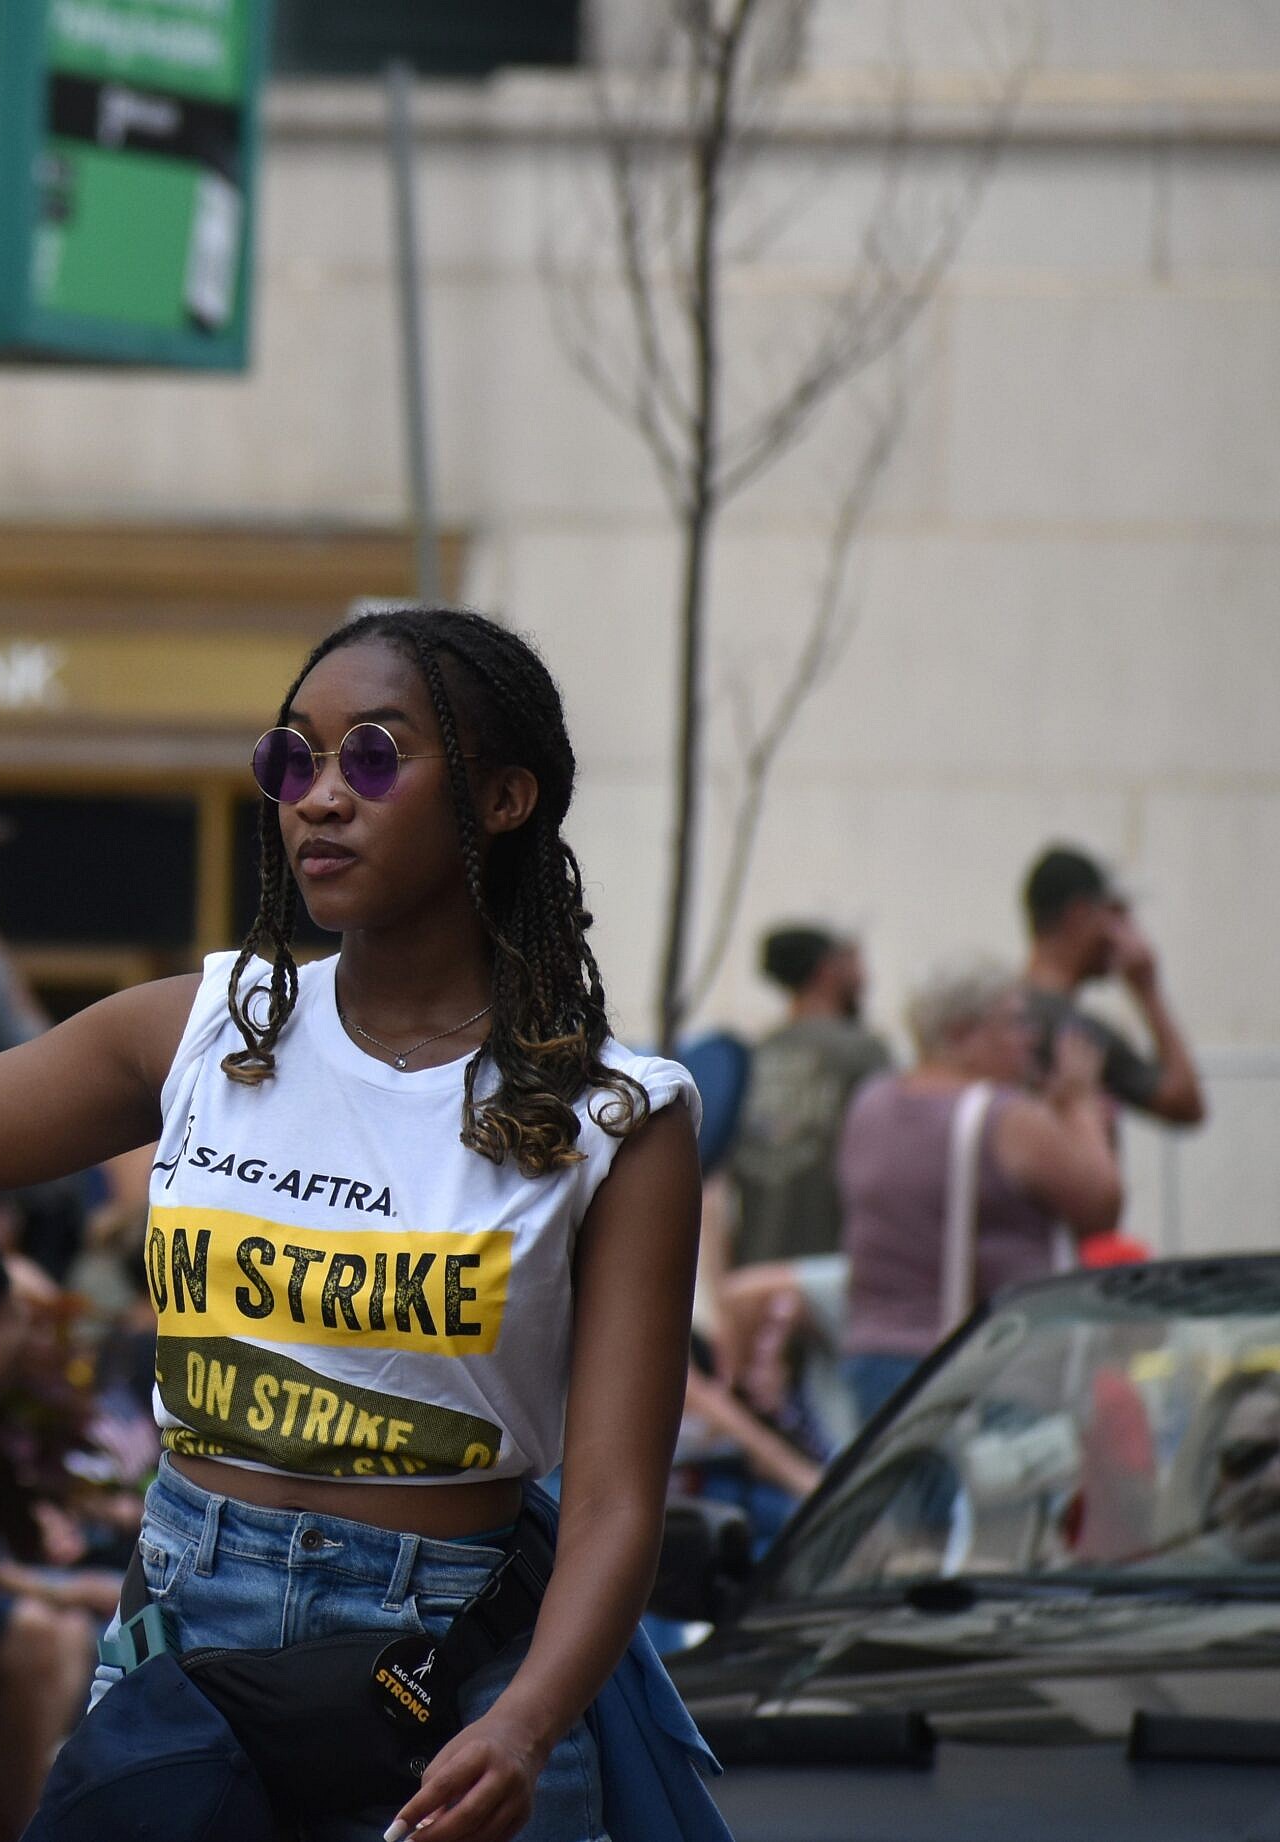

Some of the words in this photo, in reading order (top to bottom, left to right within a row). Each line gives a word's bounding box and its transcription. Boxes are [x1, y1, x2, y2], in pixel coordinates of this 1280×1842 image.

[148, 1226, 212, 1315] ON
[235, 1236, 482, 1337] STRIKE
[186, 1351, 237, 1421] ON
[246, 1374, 414, 1453] STRIKE
[376, 1669, 430, 1723] STRONG
